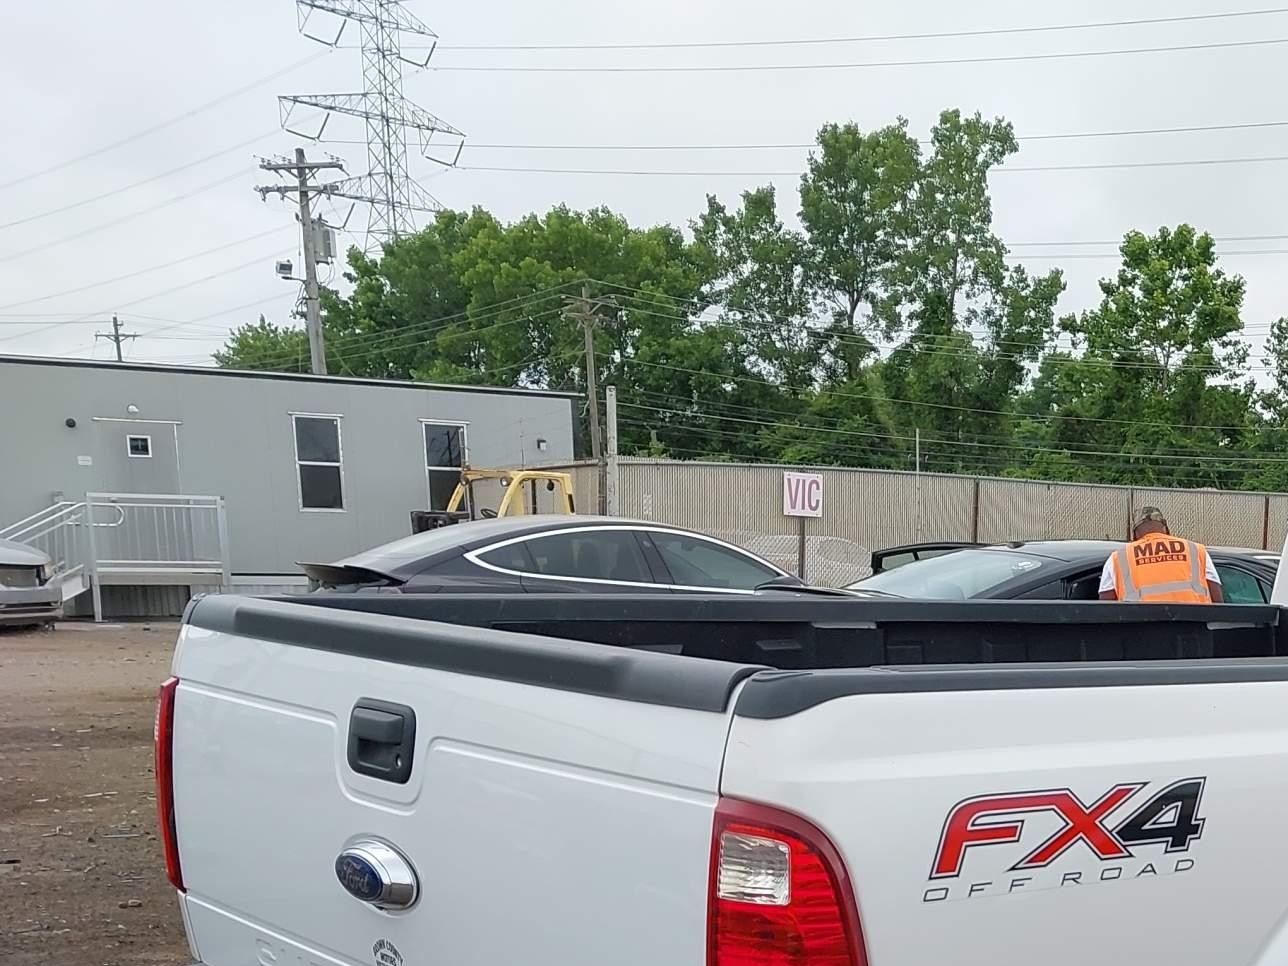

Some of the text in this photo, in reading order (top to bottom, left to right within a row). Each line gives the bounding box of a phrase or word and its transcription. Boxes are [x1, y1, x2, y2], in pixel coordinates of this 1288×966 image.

[787, 477, 820, 512] VIC
[1133, 541, 1186, 558] MAD
[1136, 554, 1187, 566] SERVICES
[928, 776, 1208, 881] FX4
[922, 858, 1195, 903] OFF ROAD
